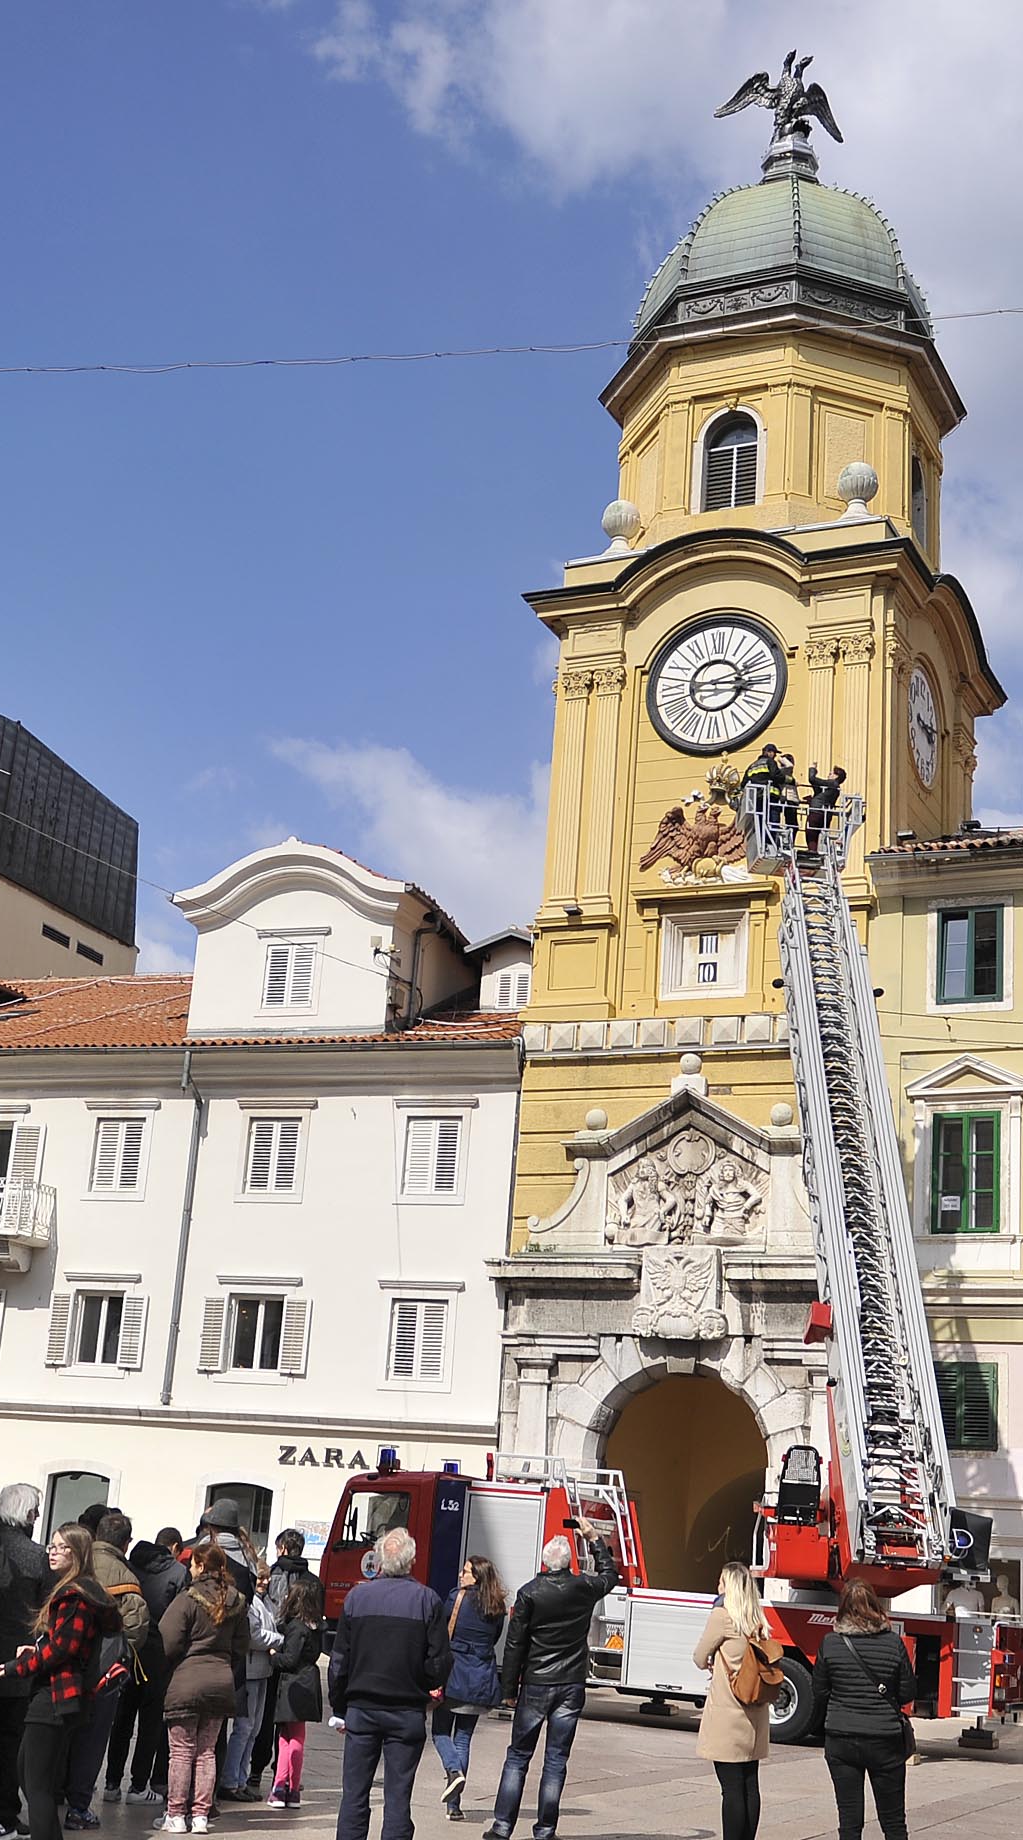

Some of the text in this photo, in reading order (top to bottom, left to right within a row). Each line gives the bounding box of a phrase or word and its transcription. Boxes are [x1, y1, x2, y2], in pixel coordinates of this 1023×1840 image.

[699, 963, 715, 983] 10
[278, 1445, 370, 1470] ZARA
[441, 1498, 459, 1511] L32
